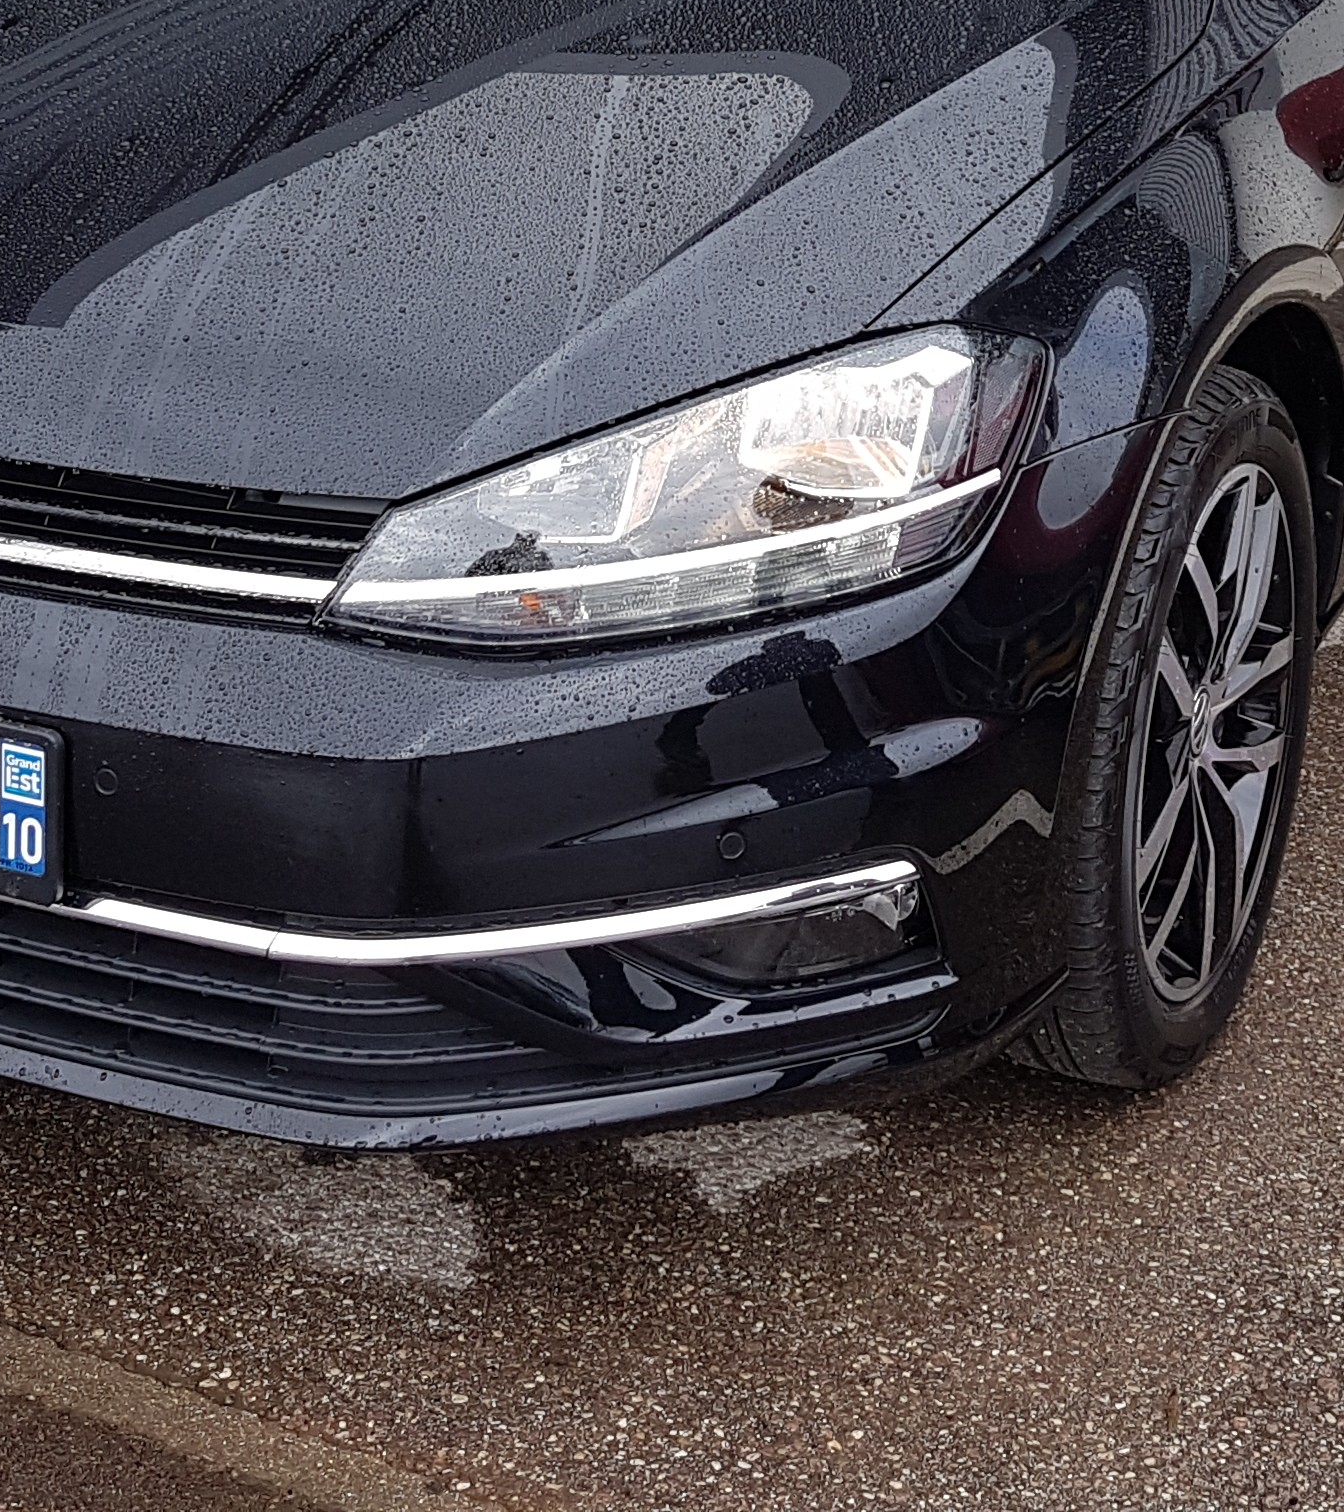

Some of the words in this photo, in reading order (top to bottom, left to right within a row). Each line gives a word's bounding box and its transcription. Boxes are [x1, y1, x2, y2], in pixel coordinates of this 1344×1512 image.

[6, 754, 41, 772] Grand
[6, 765, 41, 795] Est
[2, 812, 43, 865] 10
